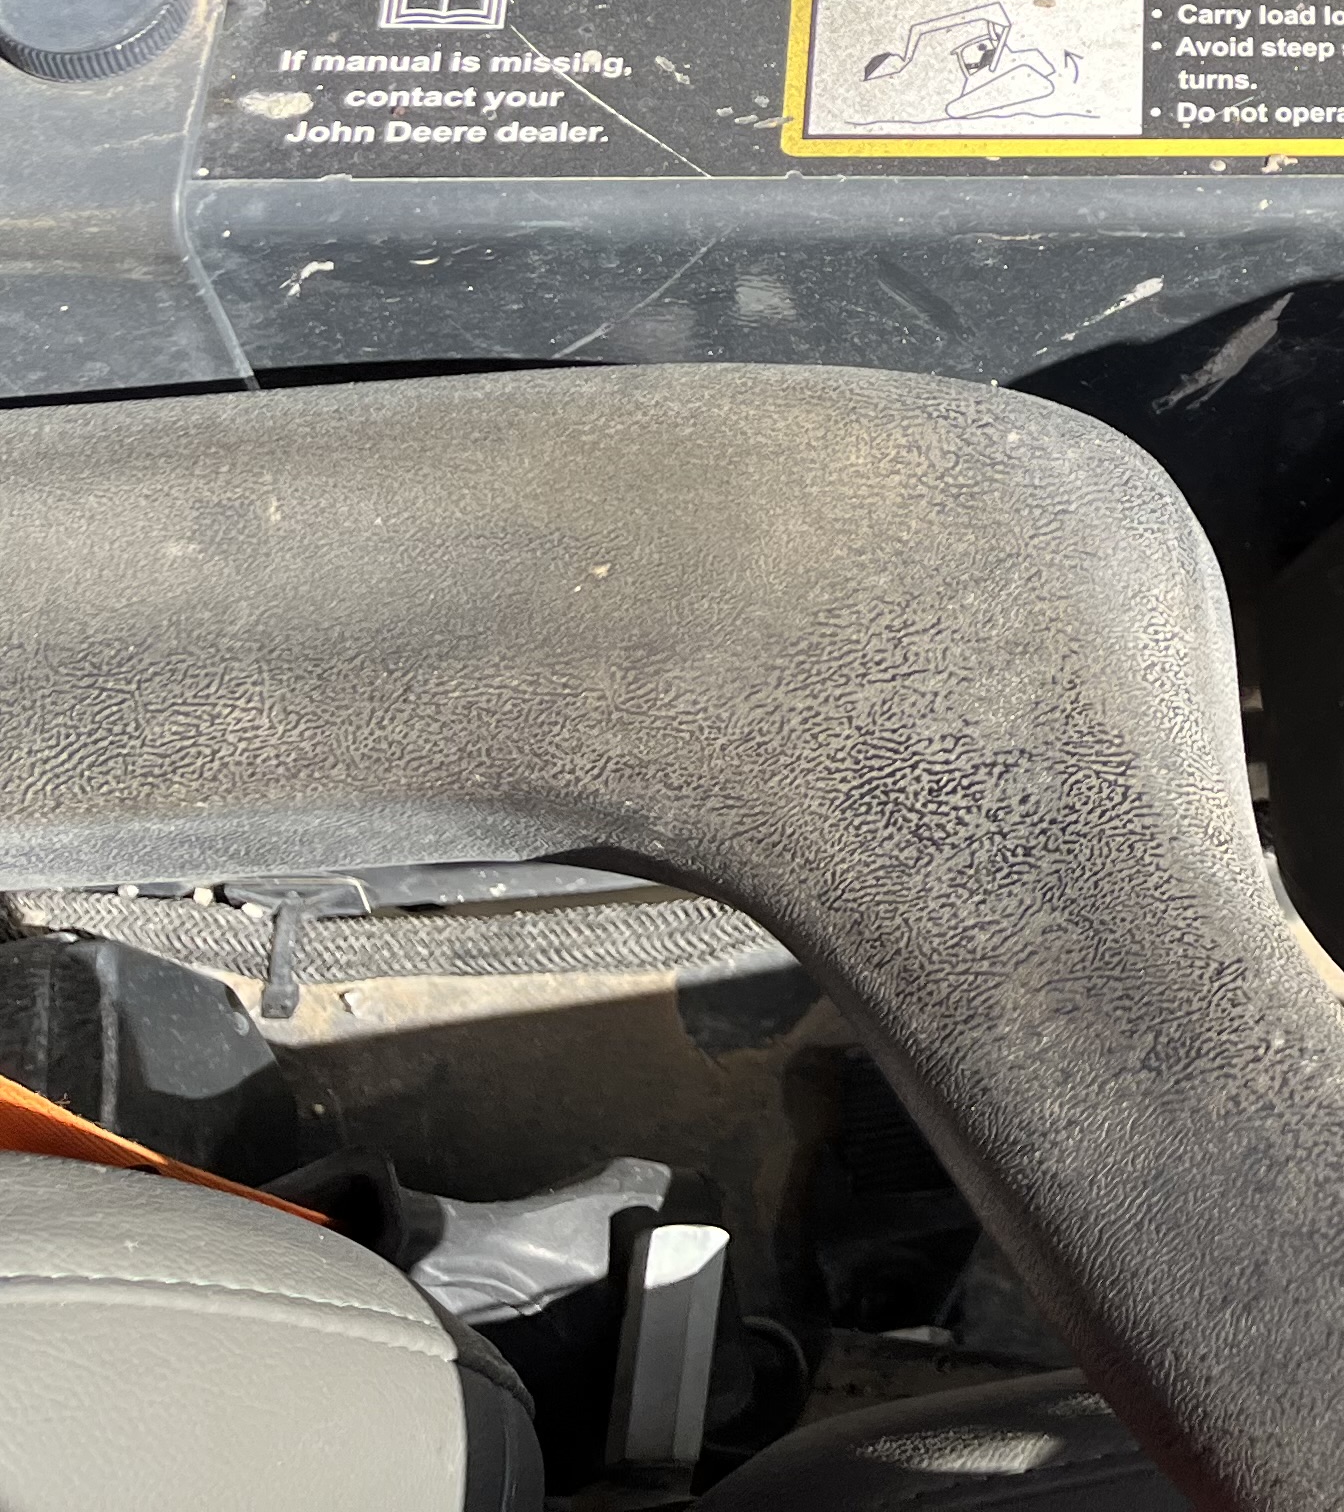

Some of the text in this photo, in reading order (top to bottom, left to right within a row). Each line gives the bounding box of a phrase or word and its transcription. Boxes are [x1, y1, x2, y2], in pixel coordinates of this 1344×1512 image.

[1177, 5, 1251, 29] Carry
[1259, 5, 1316, 26] load
[1175, 37, 1253, 58] Avoid
[1261, 40, 1335, 62] steep
[280, 49, 632, 77] If manual is missing,
[1177, 71, 1257, 90] turns.
[346, 88, 564, 112] contact your
[1176, 102, 1217, 123] Do
[1223, 104, 1269, 123] not
[286, 121, 609, 145] John Deere dealer.
